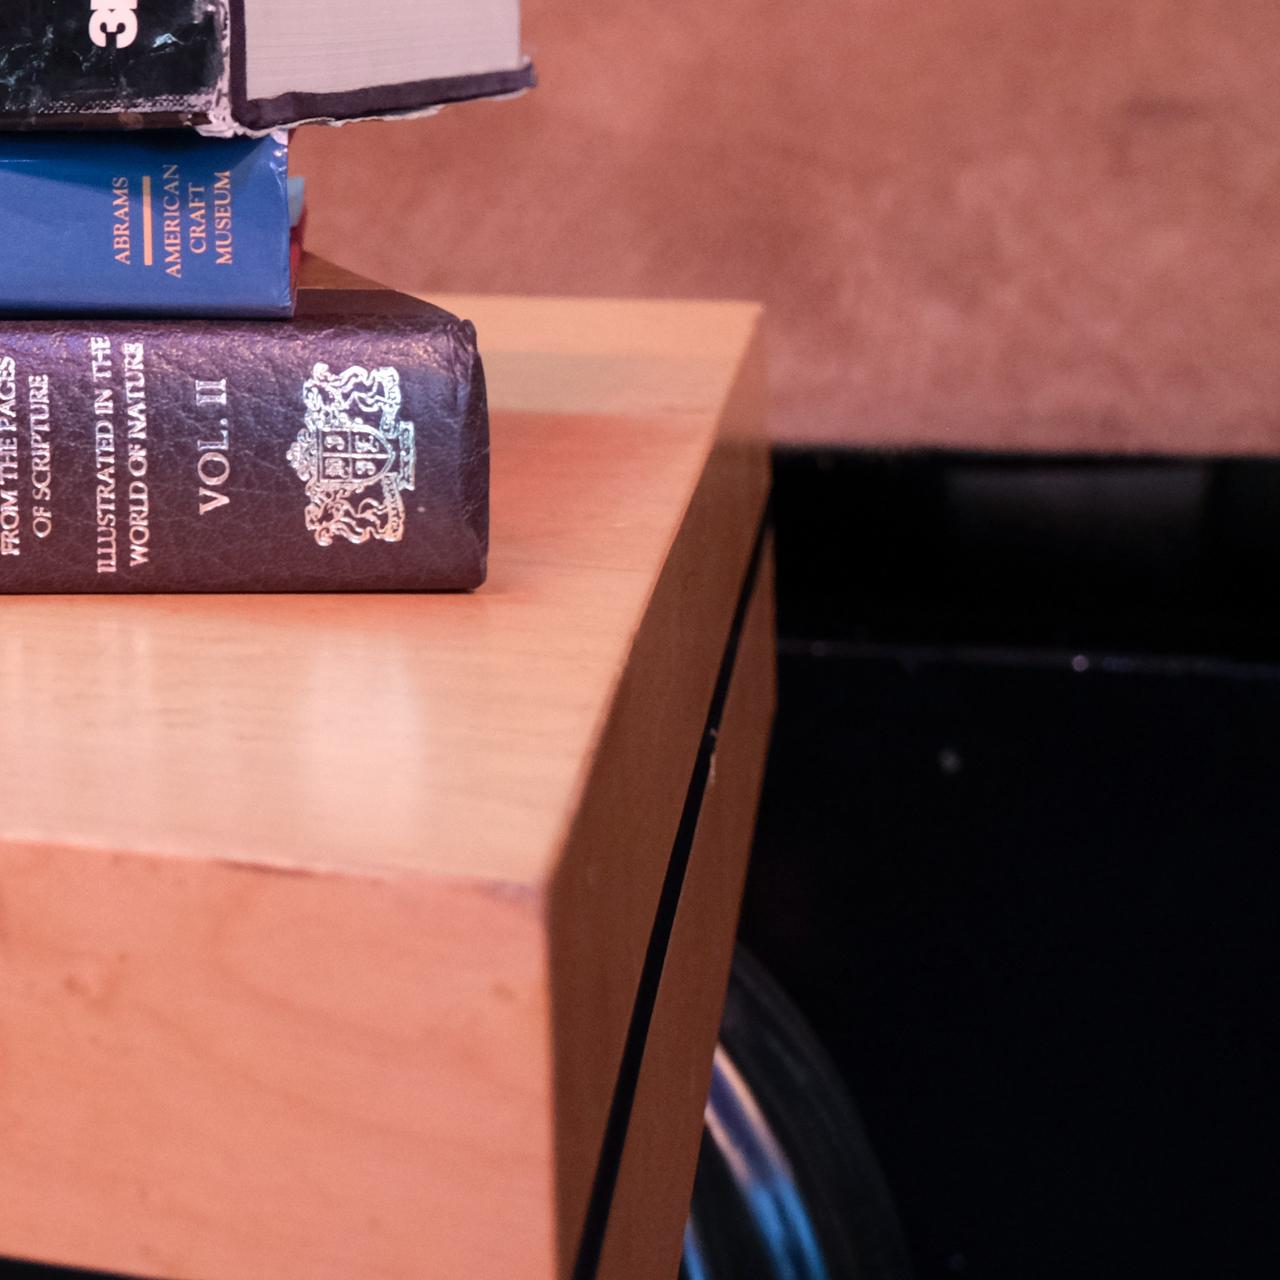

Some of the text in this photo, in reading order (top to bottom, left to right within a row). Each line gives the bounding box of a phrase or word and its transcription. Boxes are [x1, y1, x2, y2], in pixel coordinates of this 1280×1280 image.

[112, 176, 131, 265] ABRAMS
[162, 163, 182, 279] AMERICAN
[188, 181, 207, 255] CRAFT
[214, 170, 233, 265] MUSEUM
[28, 373, 52, 539] OF SCRIPTURE
[90, 335, 117, 574] ILLUSTRATED IN THE
[122, 341, 150, 568] WORLD OF NATURE
[195, 378, 231, 516] VOL. II
[0, 489, 21, 556] FROM
